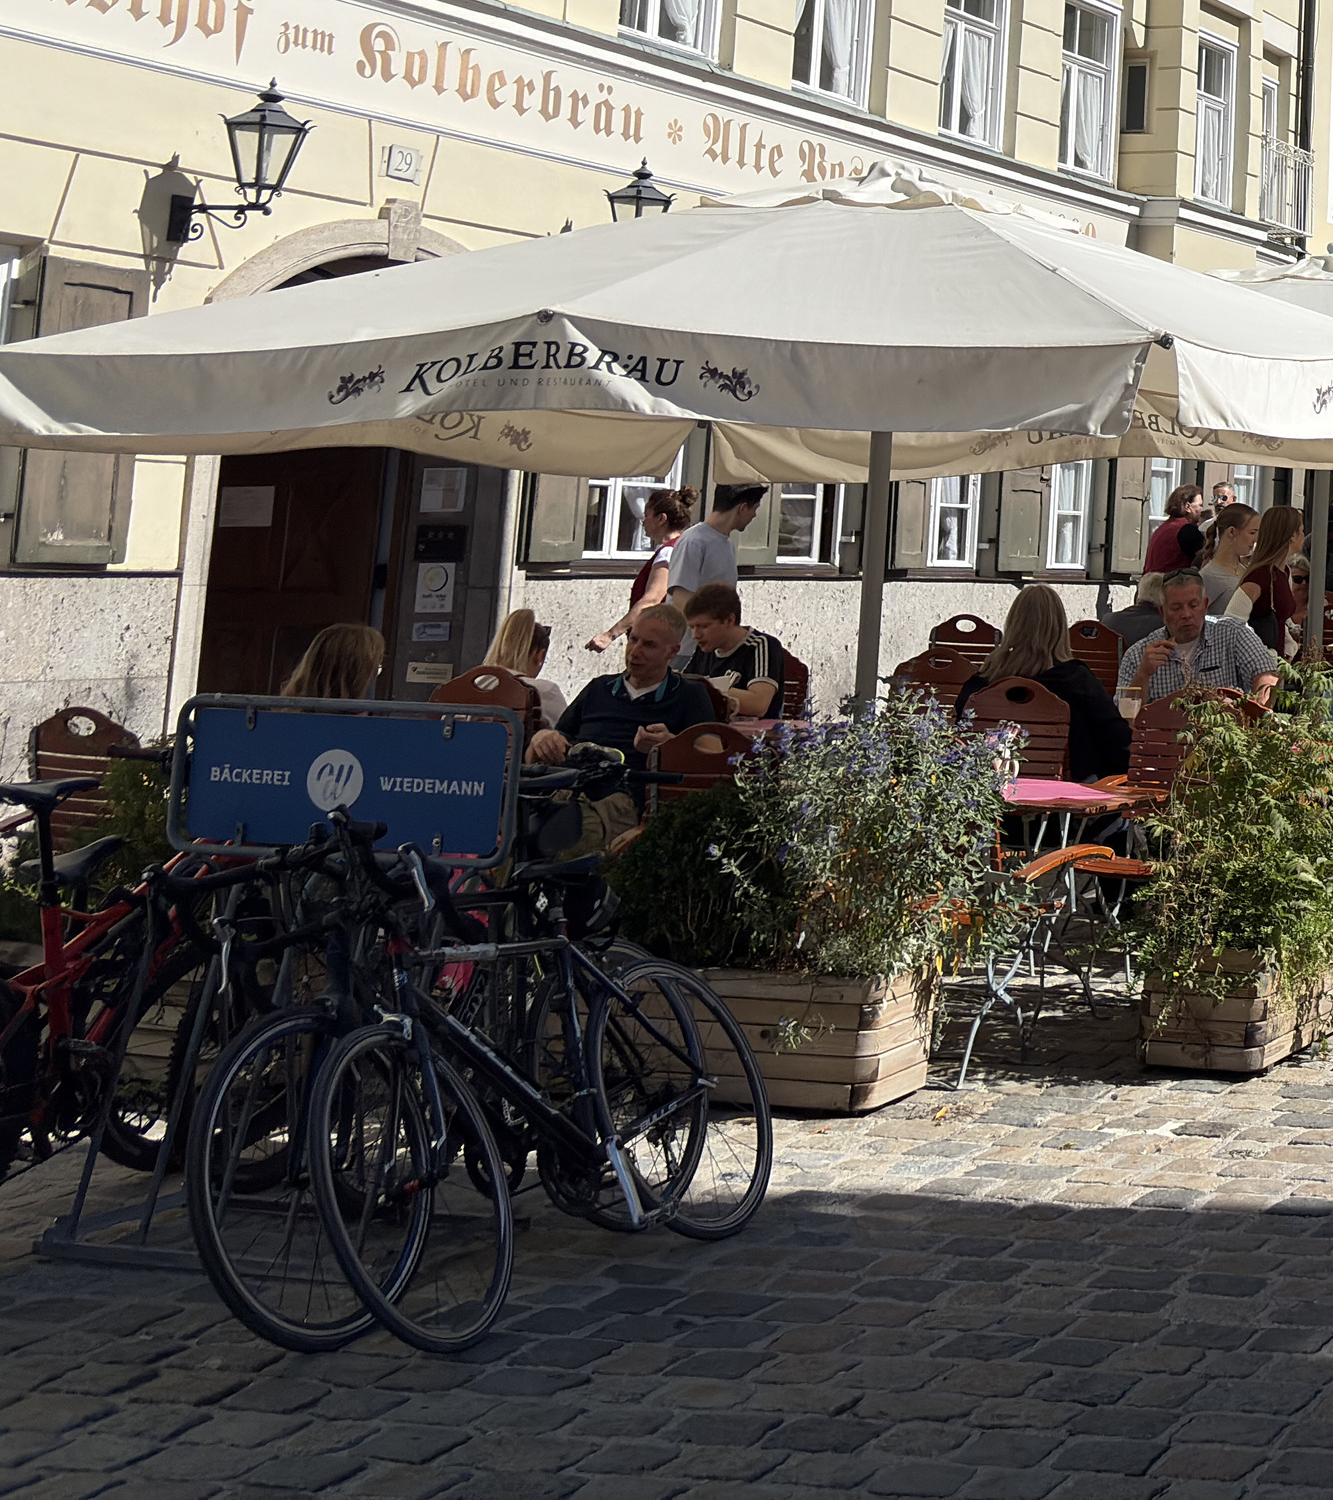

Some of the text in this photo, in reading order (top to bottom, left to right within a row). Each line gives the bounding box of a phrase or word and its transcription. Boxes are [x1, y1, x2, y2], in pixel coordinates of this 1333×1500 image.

[276, 21, 336, 57] zum
[356, 22, 644, 145] Kolberbräu
[702, 112, 784, 179] Alte
[393, 150, 414, 174] 29
[399, 341, 686, 396] KOLBERBRÄU
[497, 378, 530, 388] UND
[209, 763, 291, 787] BÄCKEREI
[379, 775, 486, 797] WIEDEMANN
